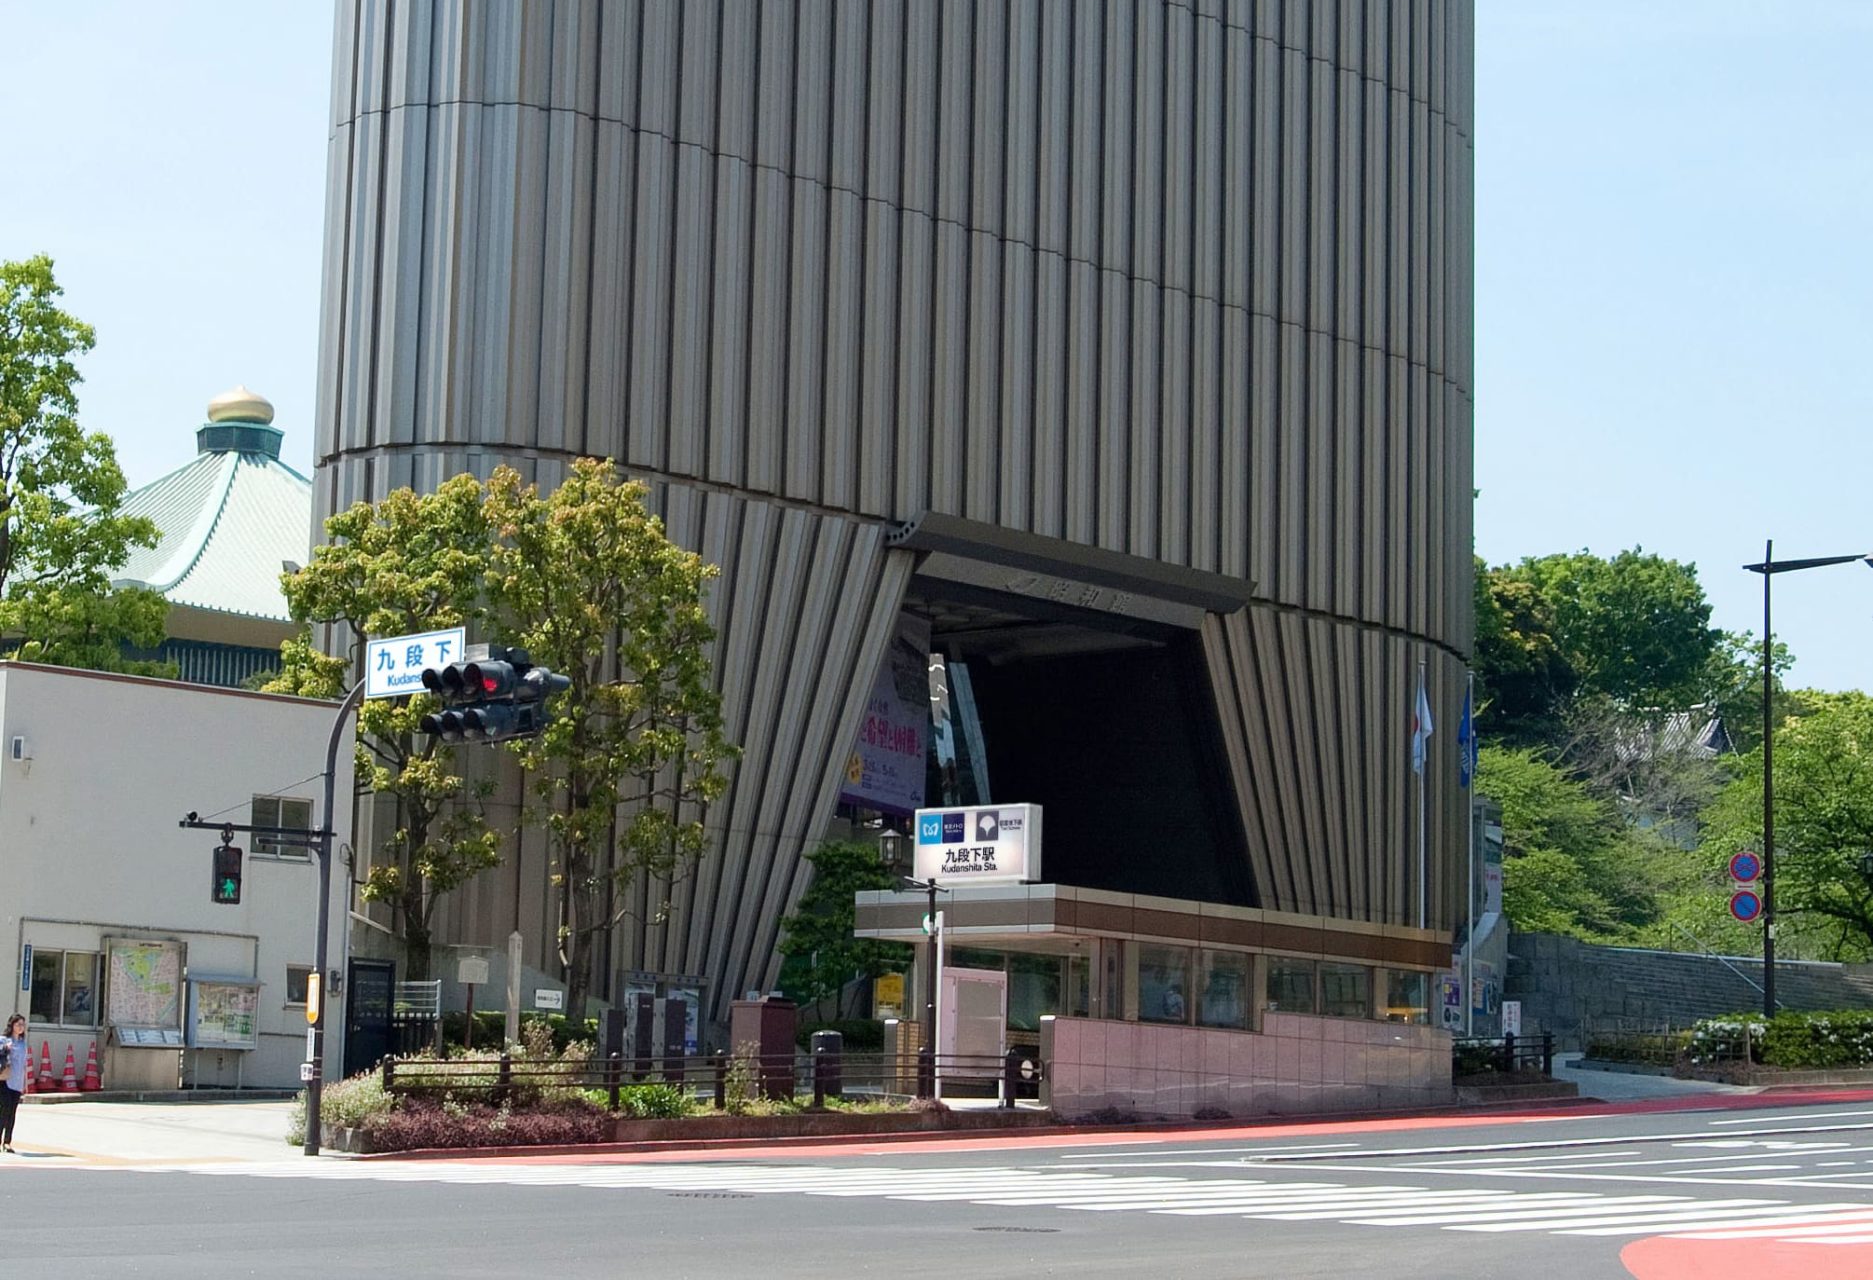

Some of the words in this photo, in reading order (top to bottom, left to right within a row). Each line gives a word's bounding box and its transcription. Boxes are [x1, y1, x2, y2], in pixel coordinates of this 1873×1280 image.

[377, 639, 451, 671] 九段下
[387, 672, 422, 687] Kudans
[945, 846, 995, 863] 九段下駅
[941, 863, 982, 874] Kudanshita
[983, 861, 998, 872] Sta.
